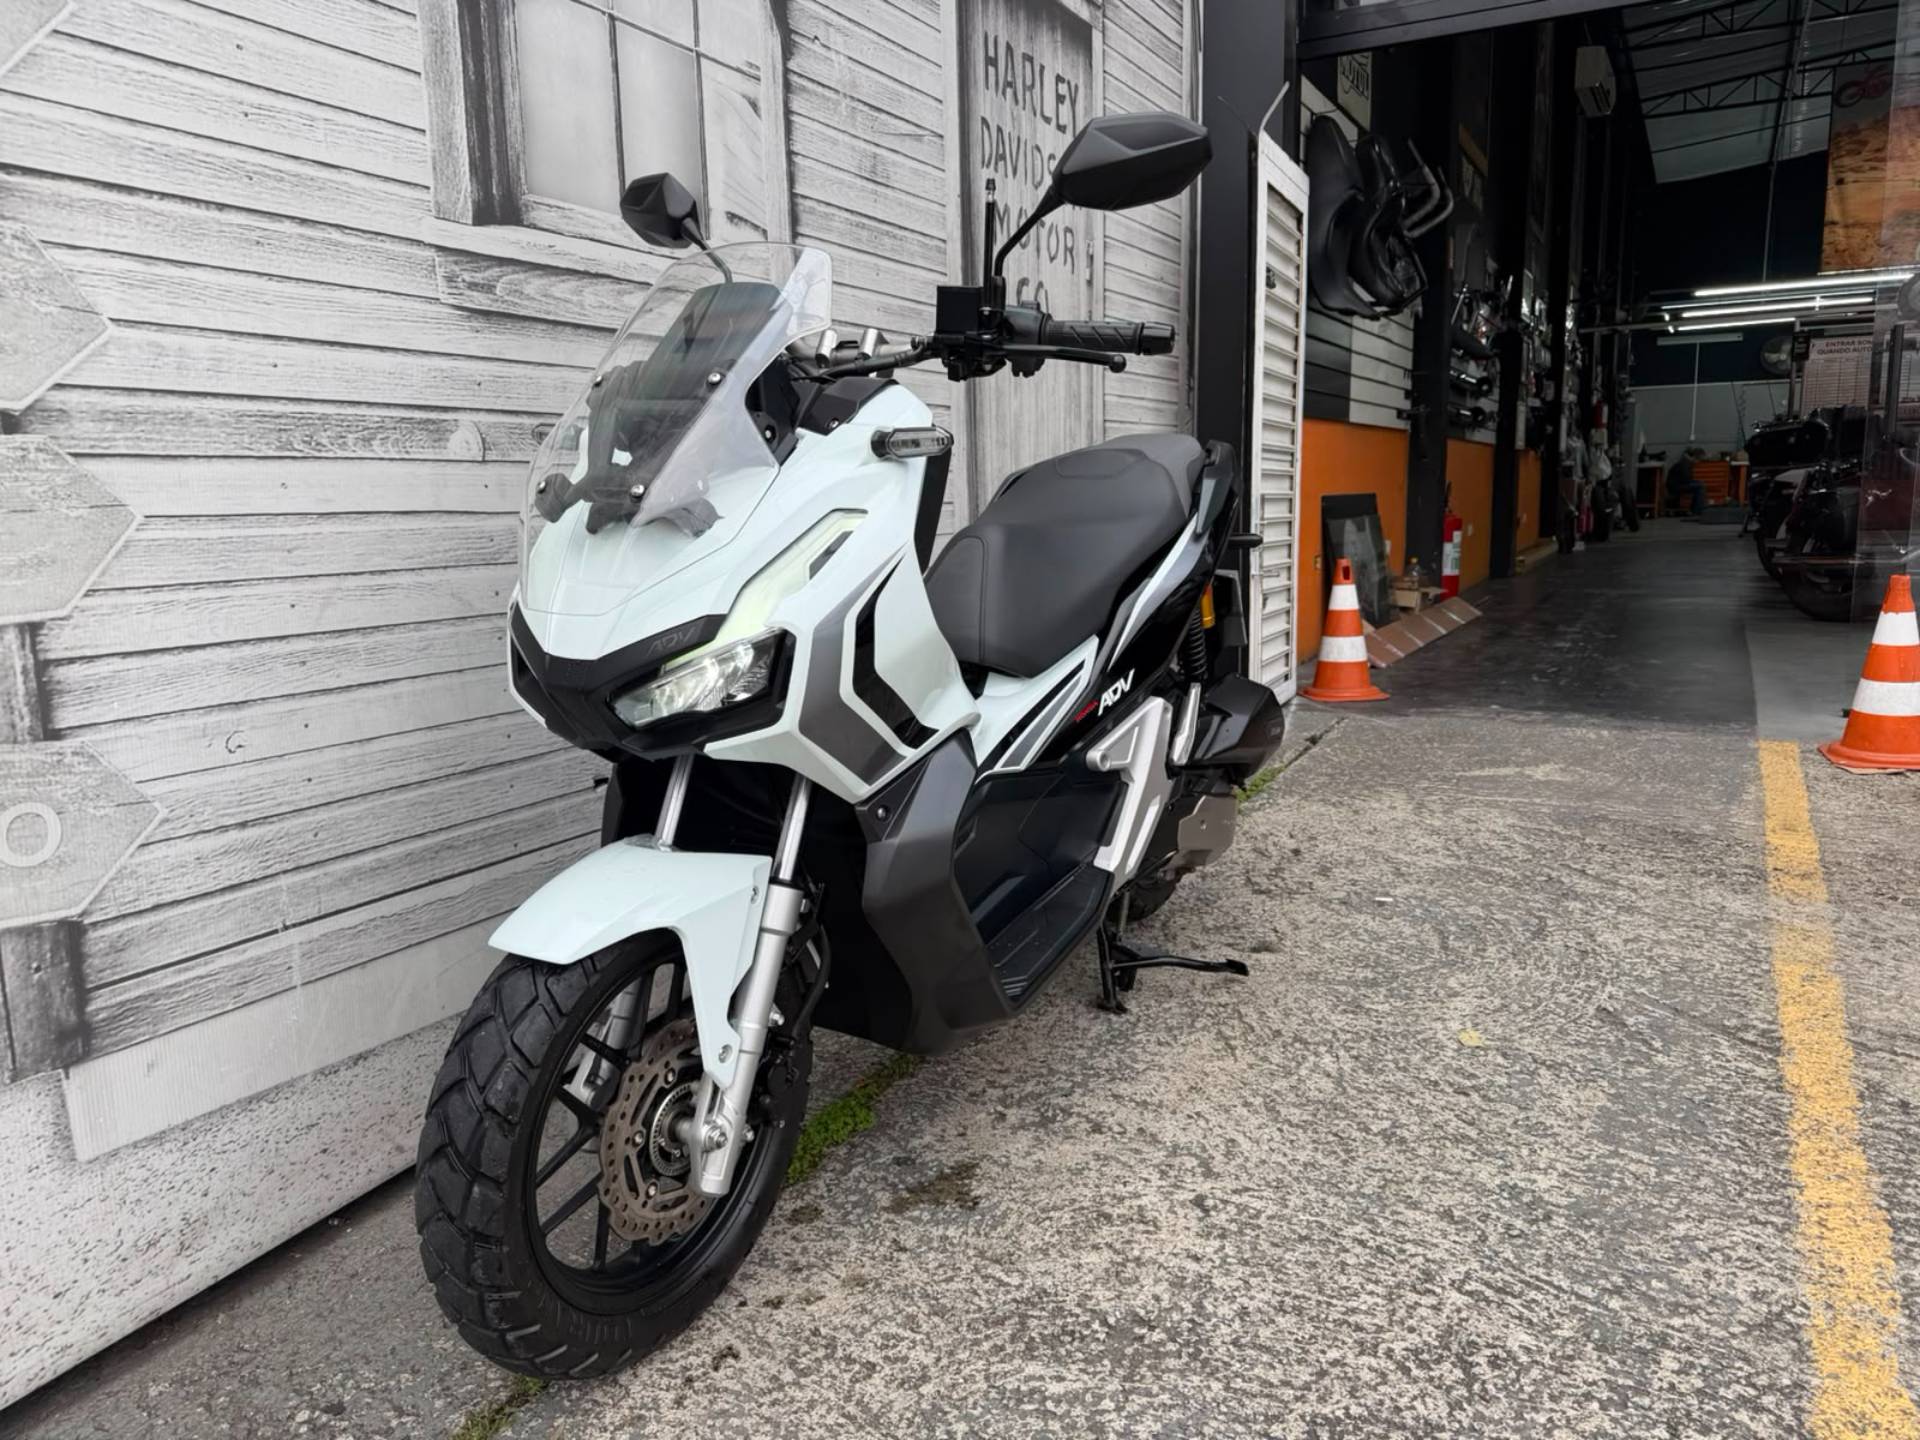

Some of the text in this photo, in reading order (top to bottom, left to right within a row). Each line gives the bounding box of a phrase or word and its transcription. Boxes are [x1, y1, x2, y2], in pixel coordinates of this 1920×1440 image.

[984, 31, 1078, 138] HARLEY
[993, 200, 1075, 274] MOTOR
[646, 627, 697, 656] ADV
[1097, 668, 1136, 716] ADV
